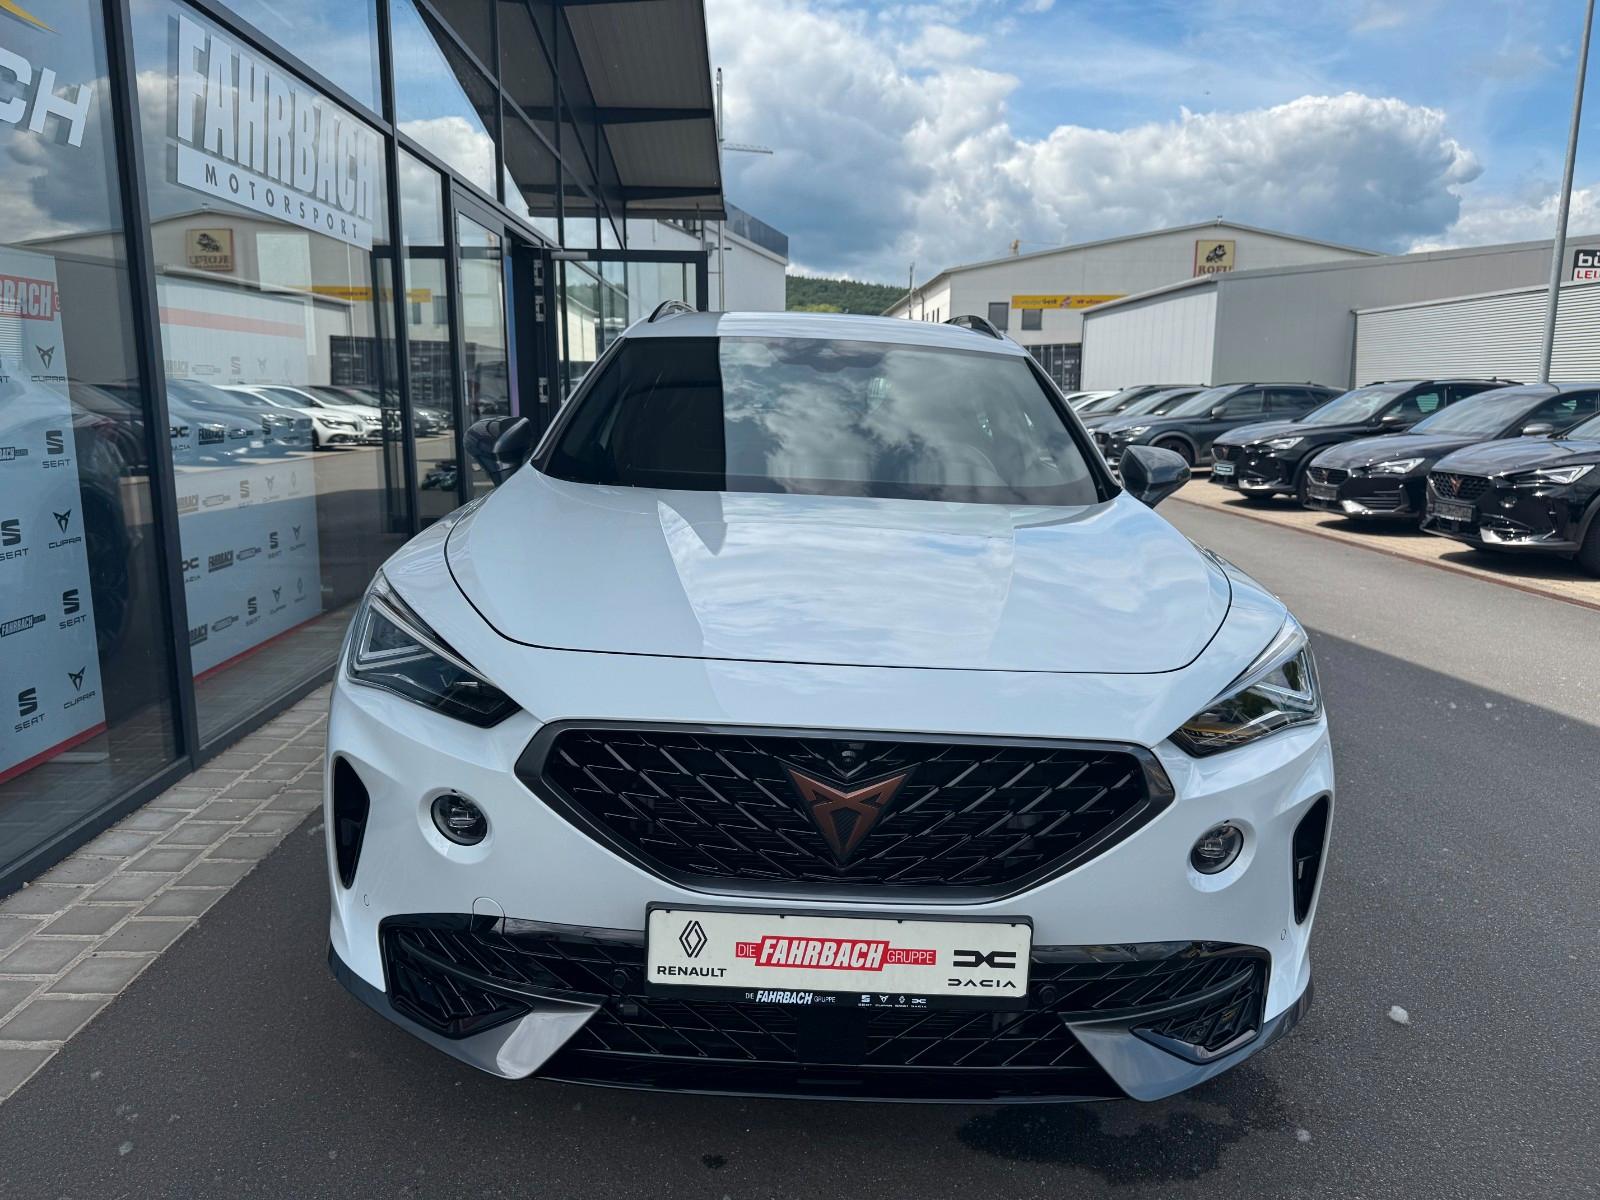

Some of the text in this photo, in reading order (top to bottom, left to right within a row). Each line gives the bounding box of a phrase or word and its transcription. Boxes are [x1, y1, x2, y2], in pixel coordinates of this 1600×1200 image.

[178, 14, 378, 220] FAHRBACH
[206, 163, 358, 239] MOTORSPORT
[0, 279, 52, 317] BACH
[41, 459, 71, 469] SEAT
[48, 536, 82, 549] CUPRA
[0, 547, 29, 561] SEAT
[59, 614, 87, 630] SEAT
[63, 690, 96, 709] CUPRA
[14, 713, 46, 733] SEAT
[737, 938, 934, 969] DIE FAHRBACH GRUPPE
[657, 965, 727, 978] RENAULT
[947, 978, 1017, 989] DACIA
[755, 990, 814, 1005] FAHRBACH
